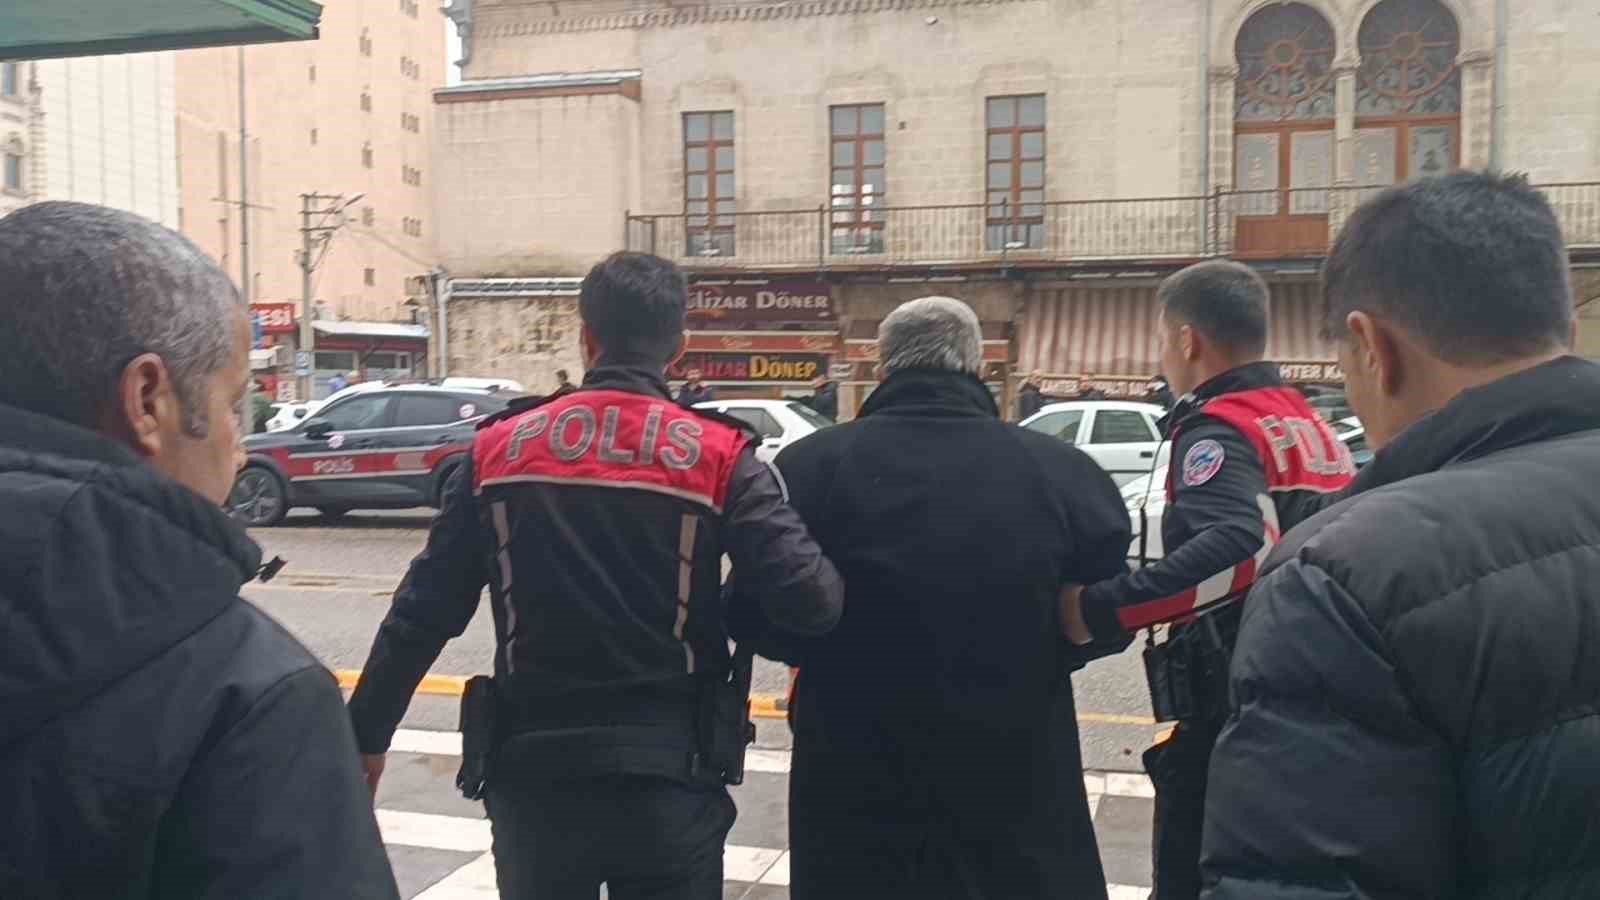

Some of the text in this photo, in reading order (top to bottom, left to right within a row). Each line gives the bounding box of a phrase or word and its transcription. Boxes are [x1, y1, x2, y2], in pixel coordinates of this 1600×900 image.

[756, 291, 828, 309] DÖNER
[1280, 364, 1321, 379] HTER
[505, 404, 702, 470] POLİS
